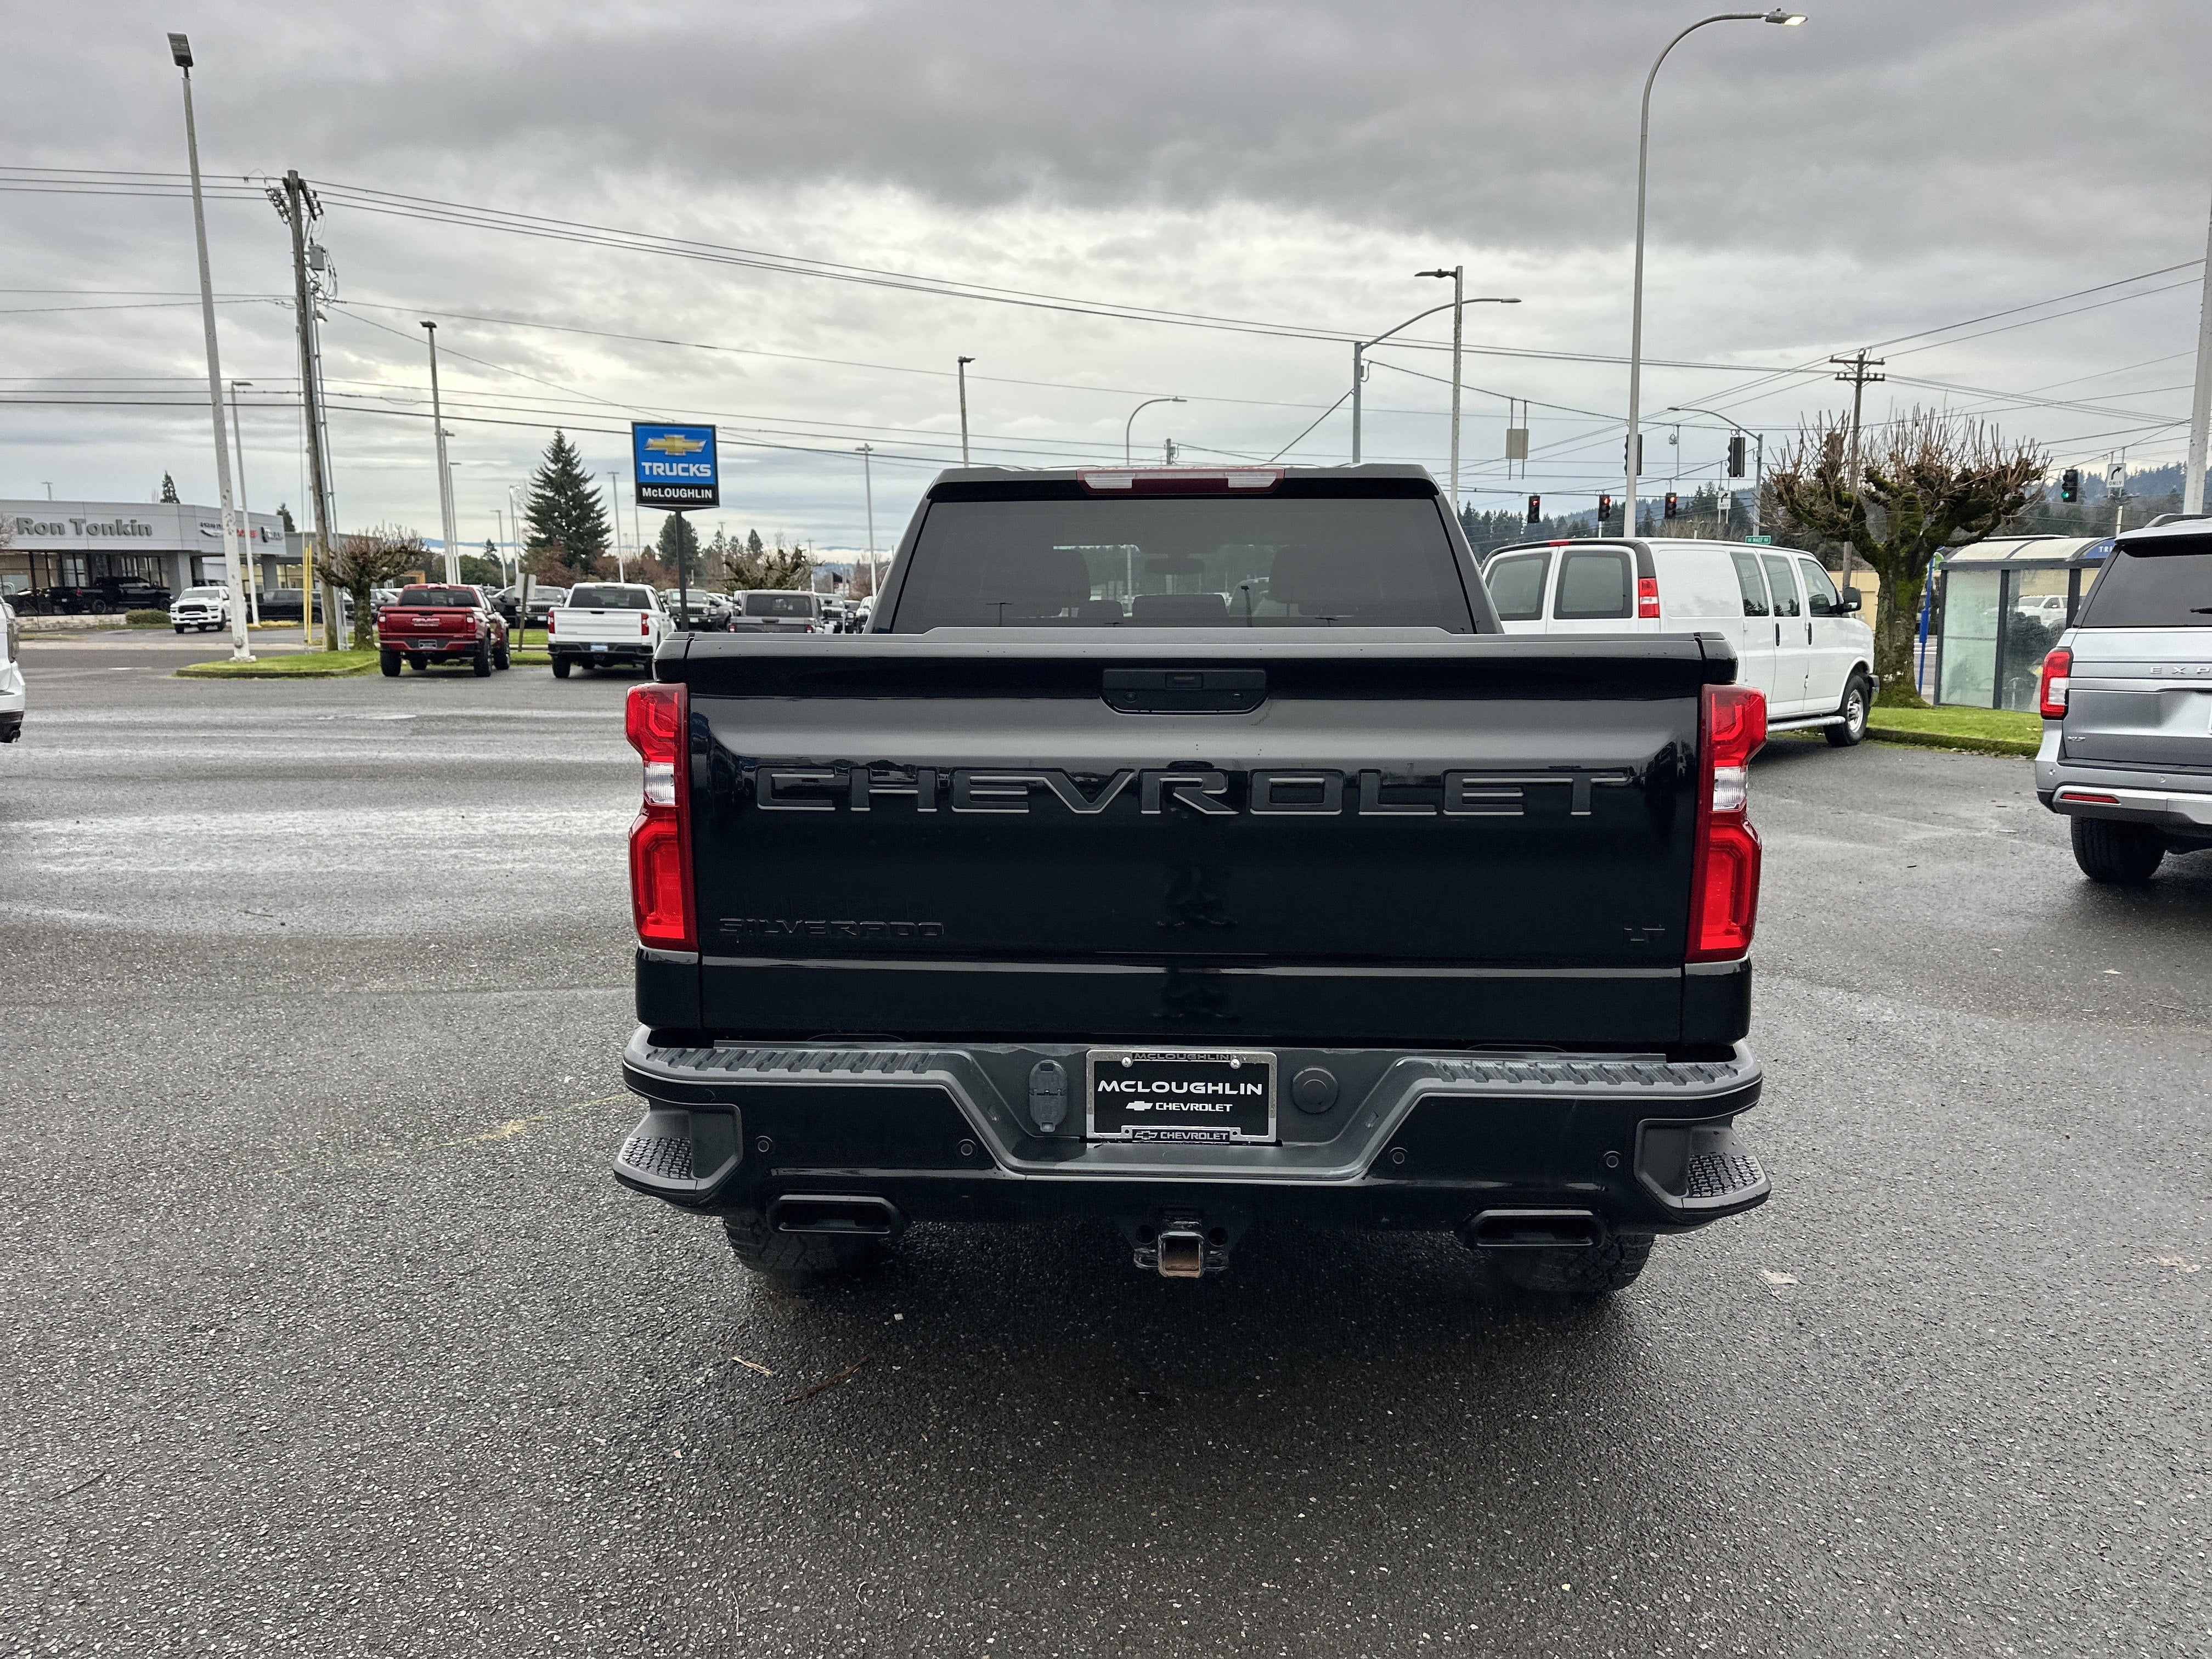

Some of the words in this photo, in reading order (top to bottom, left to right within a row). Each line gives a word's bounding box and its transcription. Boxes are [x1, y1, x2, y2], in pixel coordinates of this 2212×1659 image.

[641, 462, 712, 477] TRUCKS
[642, 487, 712, 499] McLOUGHLIN
[16, 517, 66, 535] Ron
[69, 518, 153, 537] Tonkin
[755, 766, 1633, 815] CHEVROLET
[719, 918, 945, 936] SILVERADO
[1098, 1080, 1262, 1094] MCLOUGHLIN
[1156, 1103, 1232, 1111] CHEVROLET
[1160, 1132, 1228, 1140] CHEVROLET
